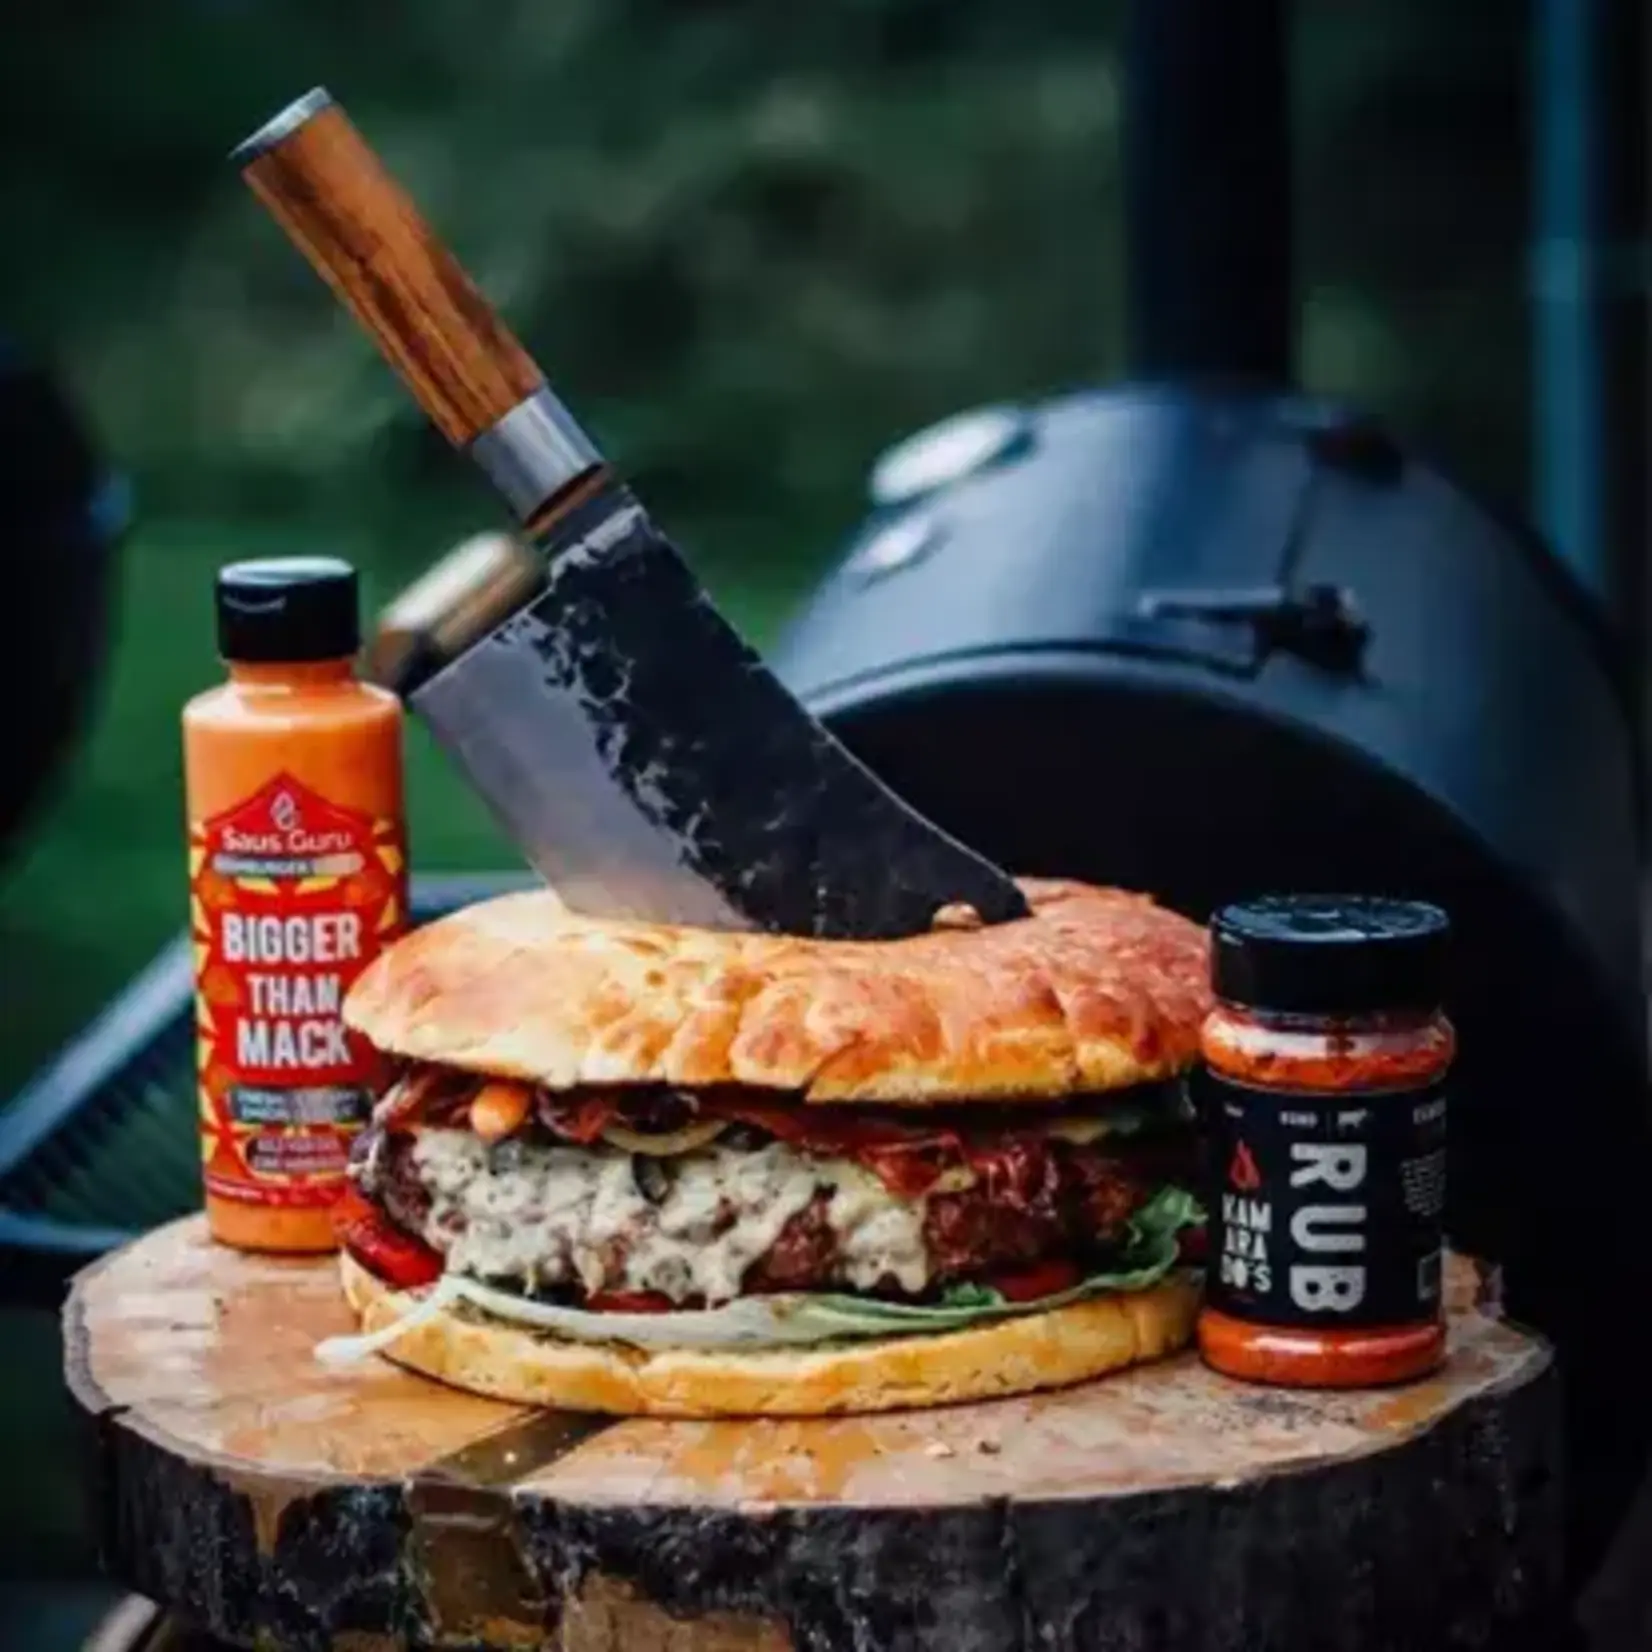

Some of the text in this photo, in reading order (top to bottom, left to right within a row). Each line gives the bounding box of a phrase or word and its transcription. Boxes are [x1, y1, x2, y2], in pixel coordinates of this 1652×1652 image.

[222, 912, 361, 963] BIGGER
[246, 973, 340, 1014] THAN
[237, 1017, 352, 1068] MACK
[1290, 1143, 1367, 1311] RUB
